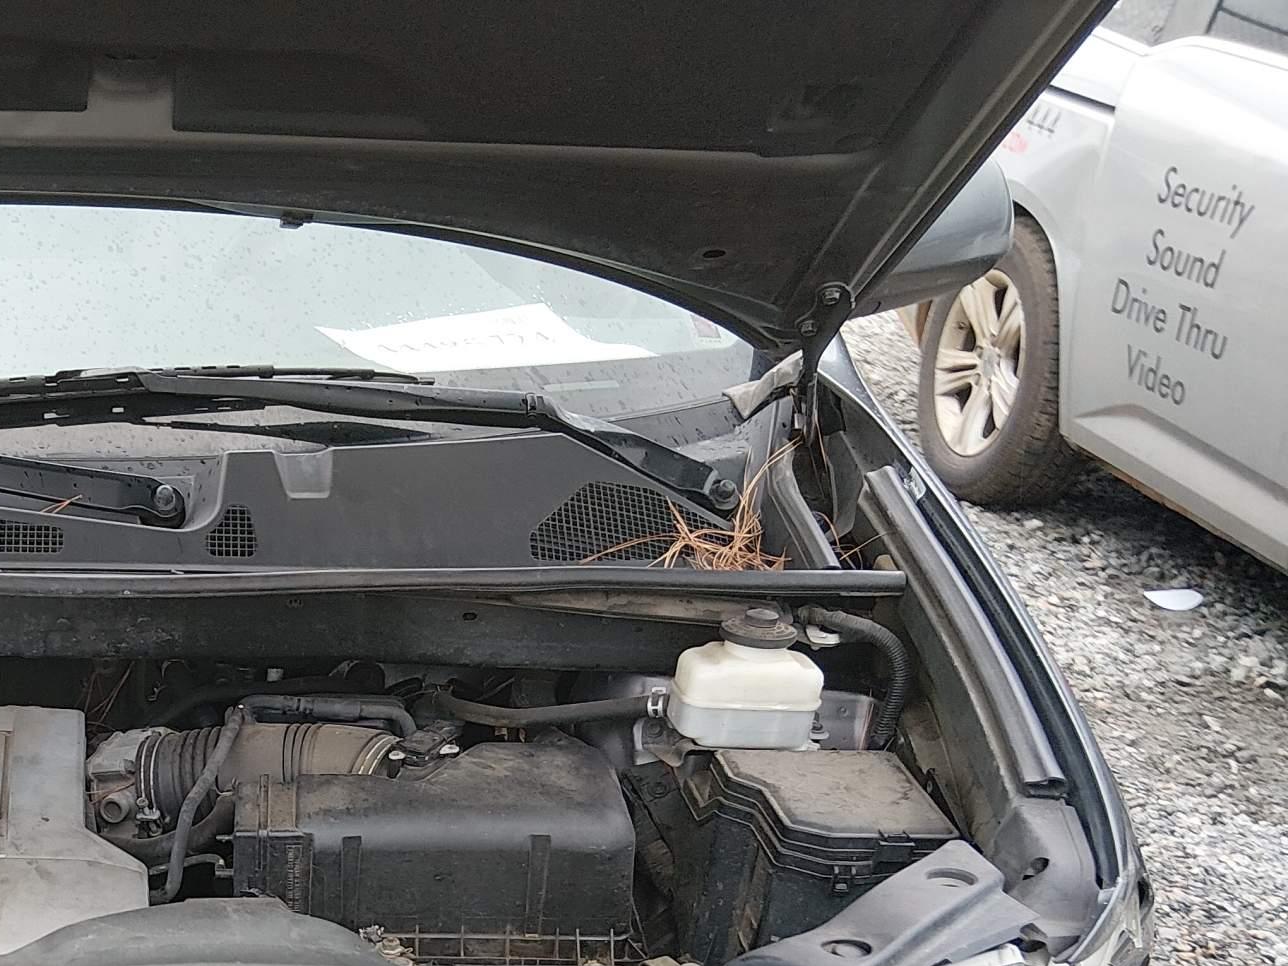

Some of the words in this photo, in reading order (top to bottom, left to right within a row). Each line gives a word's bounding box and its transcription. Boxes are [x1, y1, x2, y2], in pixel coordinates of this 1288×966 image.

[1156, 165, 1256, 239] Security
[1146, 227, 1227, 289] Sound
[1111, 278, 1168, 335] Drive
[1174, 303, 1228, 360] Thru
[1126, 343, 1187, 406] Video
